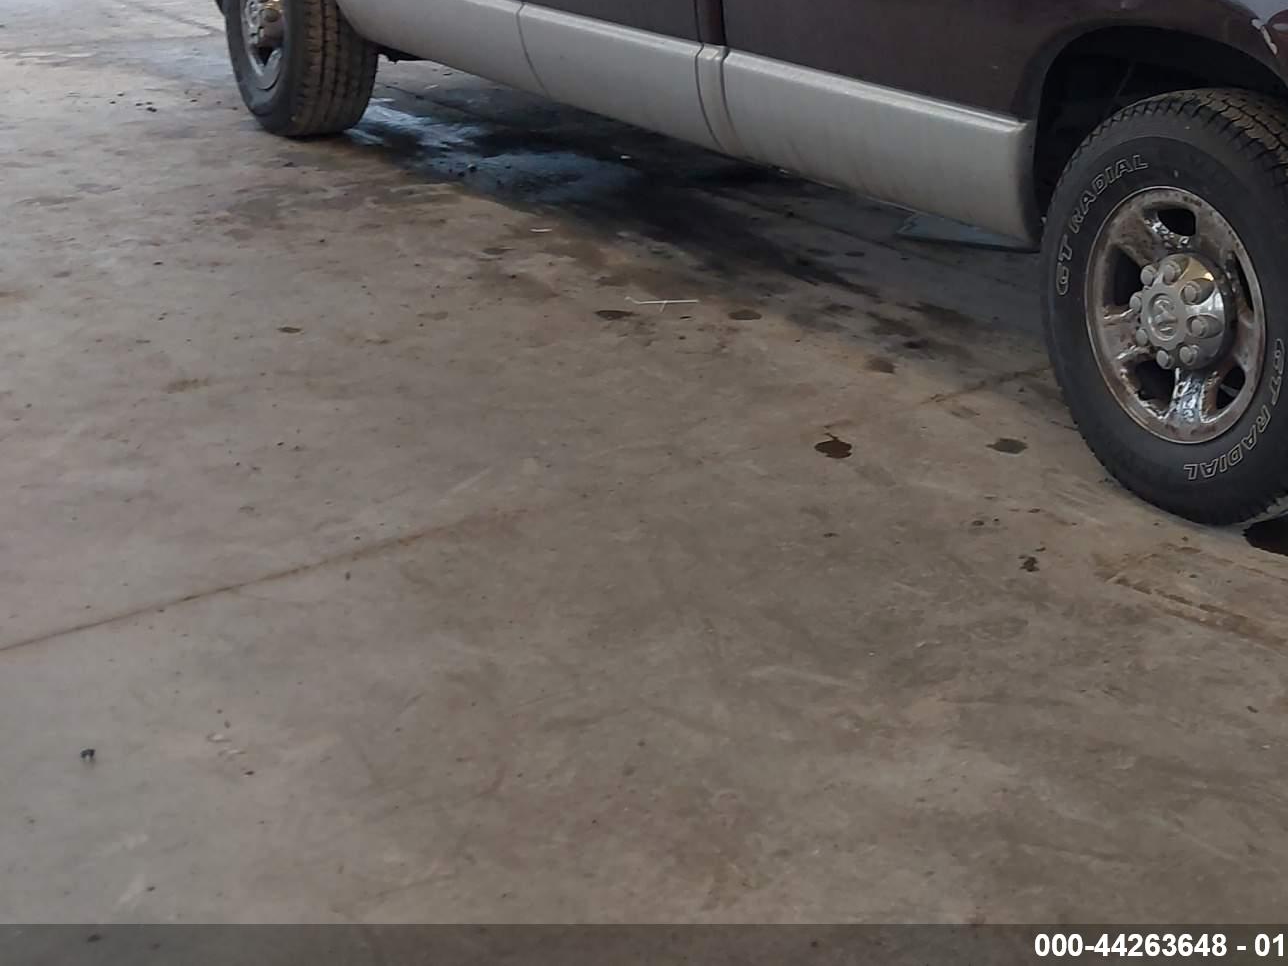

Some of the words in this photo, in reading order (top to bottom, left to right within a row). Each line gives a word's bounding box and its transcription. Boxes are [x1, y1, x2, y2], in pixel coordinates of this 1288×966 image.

[1056, 234, 1072, 295] GT
[1069, 154, 1149, 234] RADIAL
[1269, 338, 1285, 405] GT
[1184, 404, 1271, 480] RADIAL
